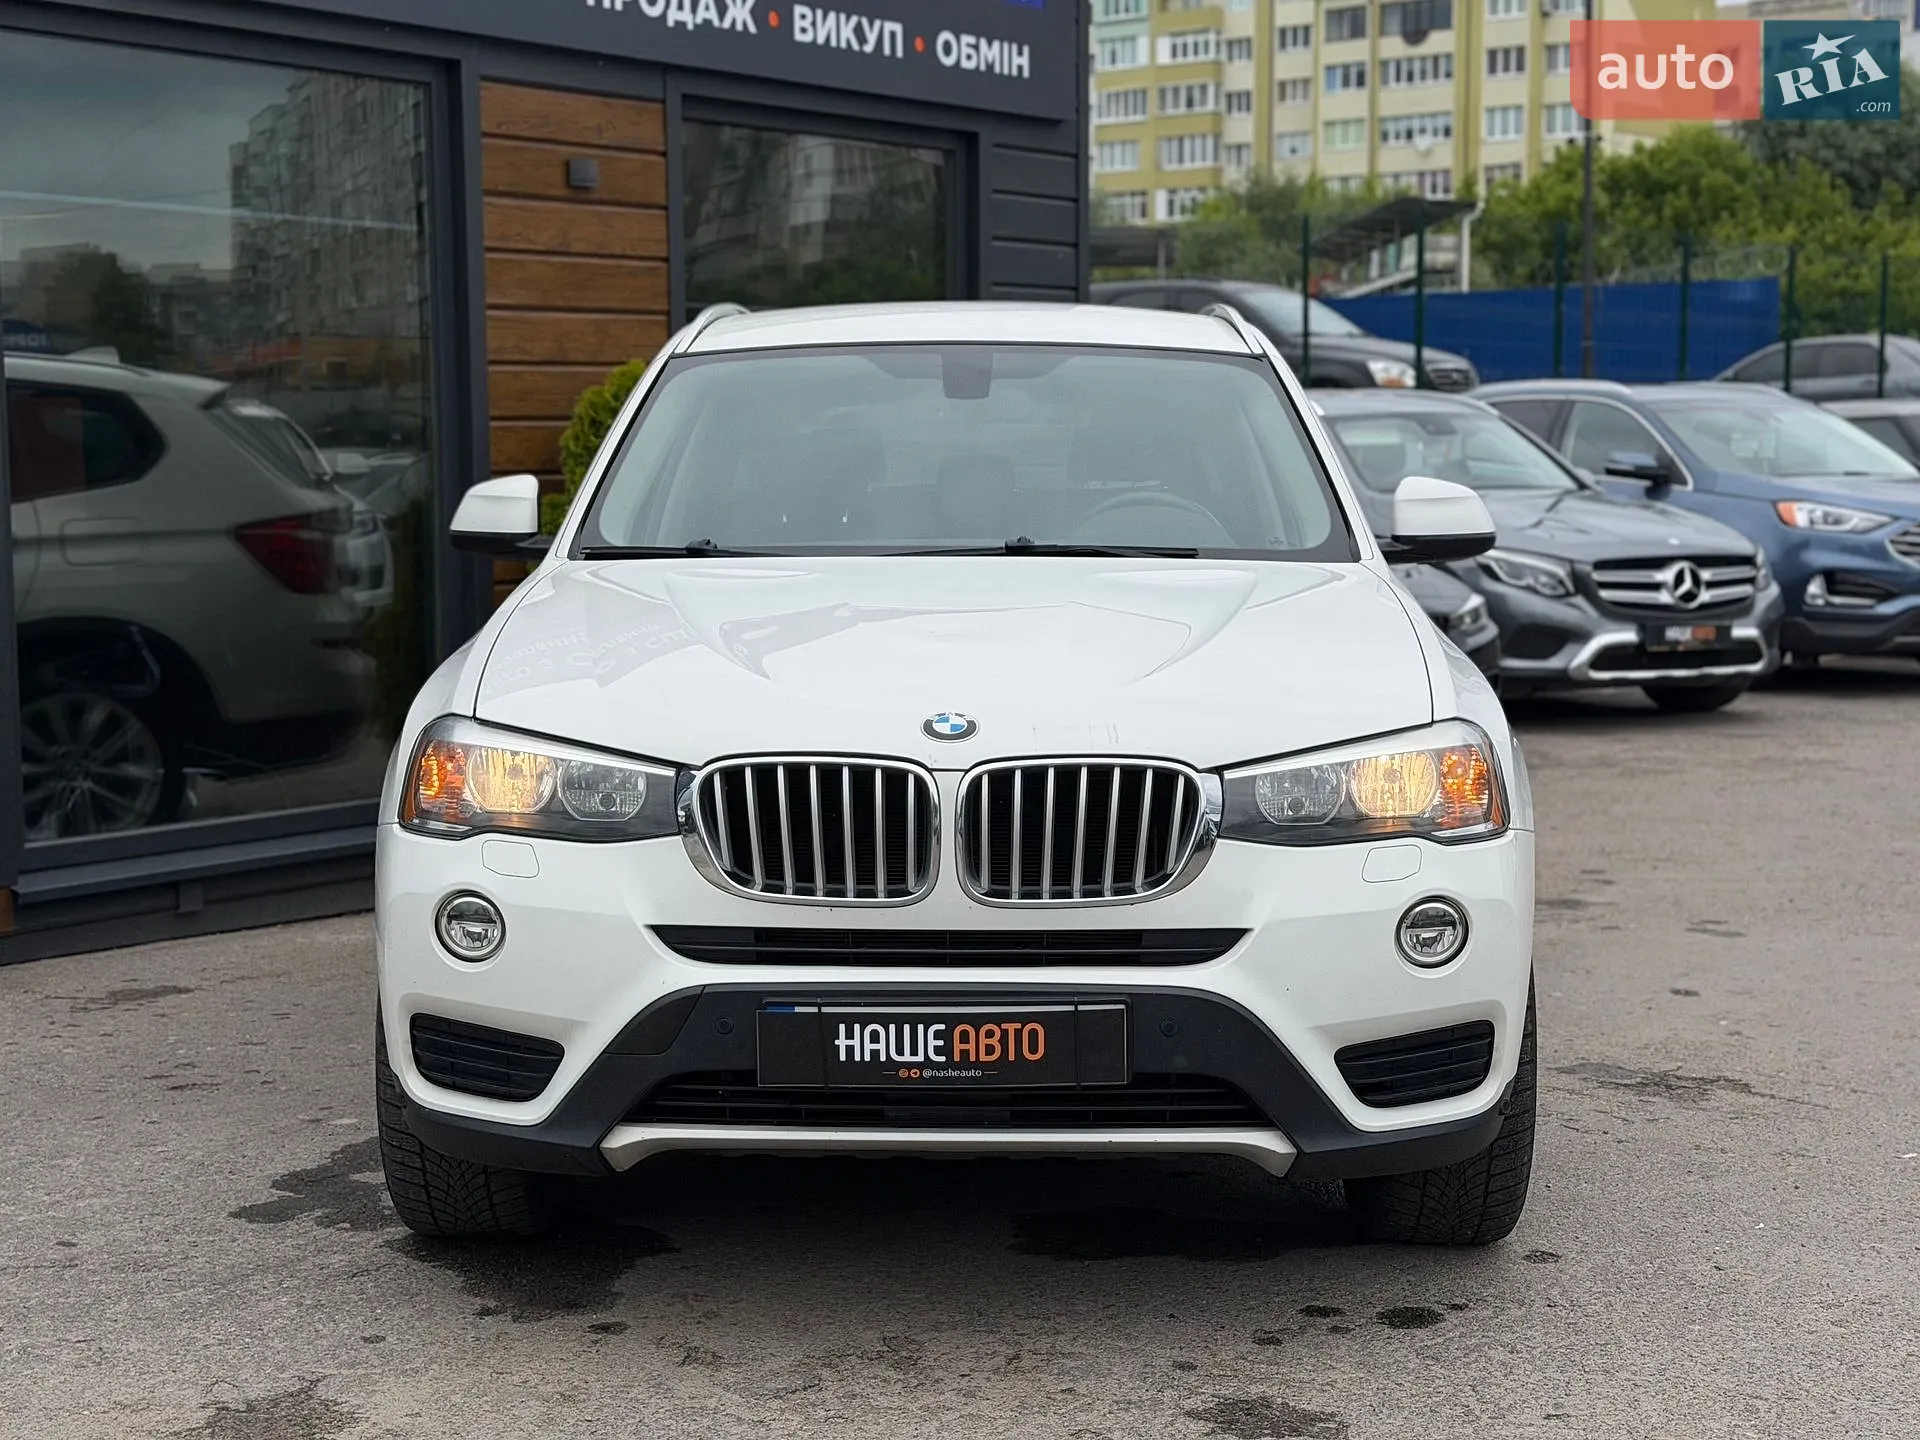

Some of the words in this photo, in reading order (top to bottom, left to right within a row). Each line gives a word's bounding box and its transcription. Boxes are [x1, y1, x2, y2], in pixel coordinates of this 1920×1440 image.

[586, 0, 758, 34] ОДАЖ
[793, 5, 904, 58] ВИКУП
[935, 30, 1031, 79] ОБМІН
[834, 1023, 946, 1062] НАШЕ
[953, 1022, 1045, 1062] АВТО
[922, 1067, 982, 1079] @nasheauto
